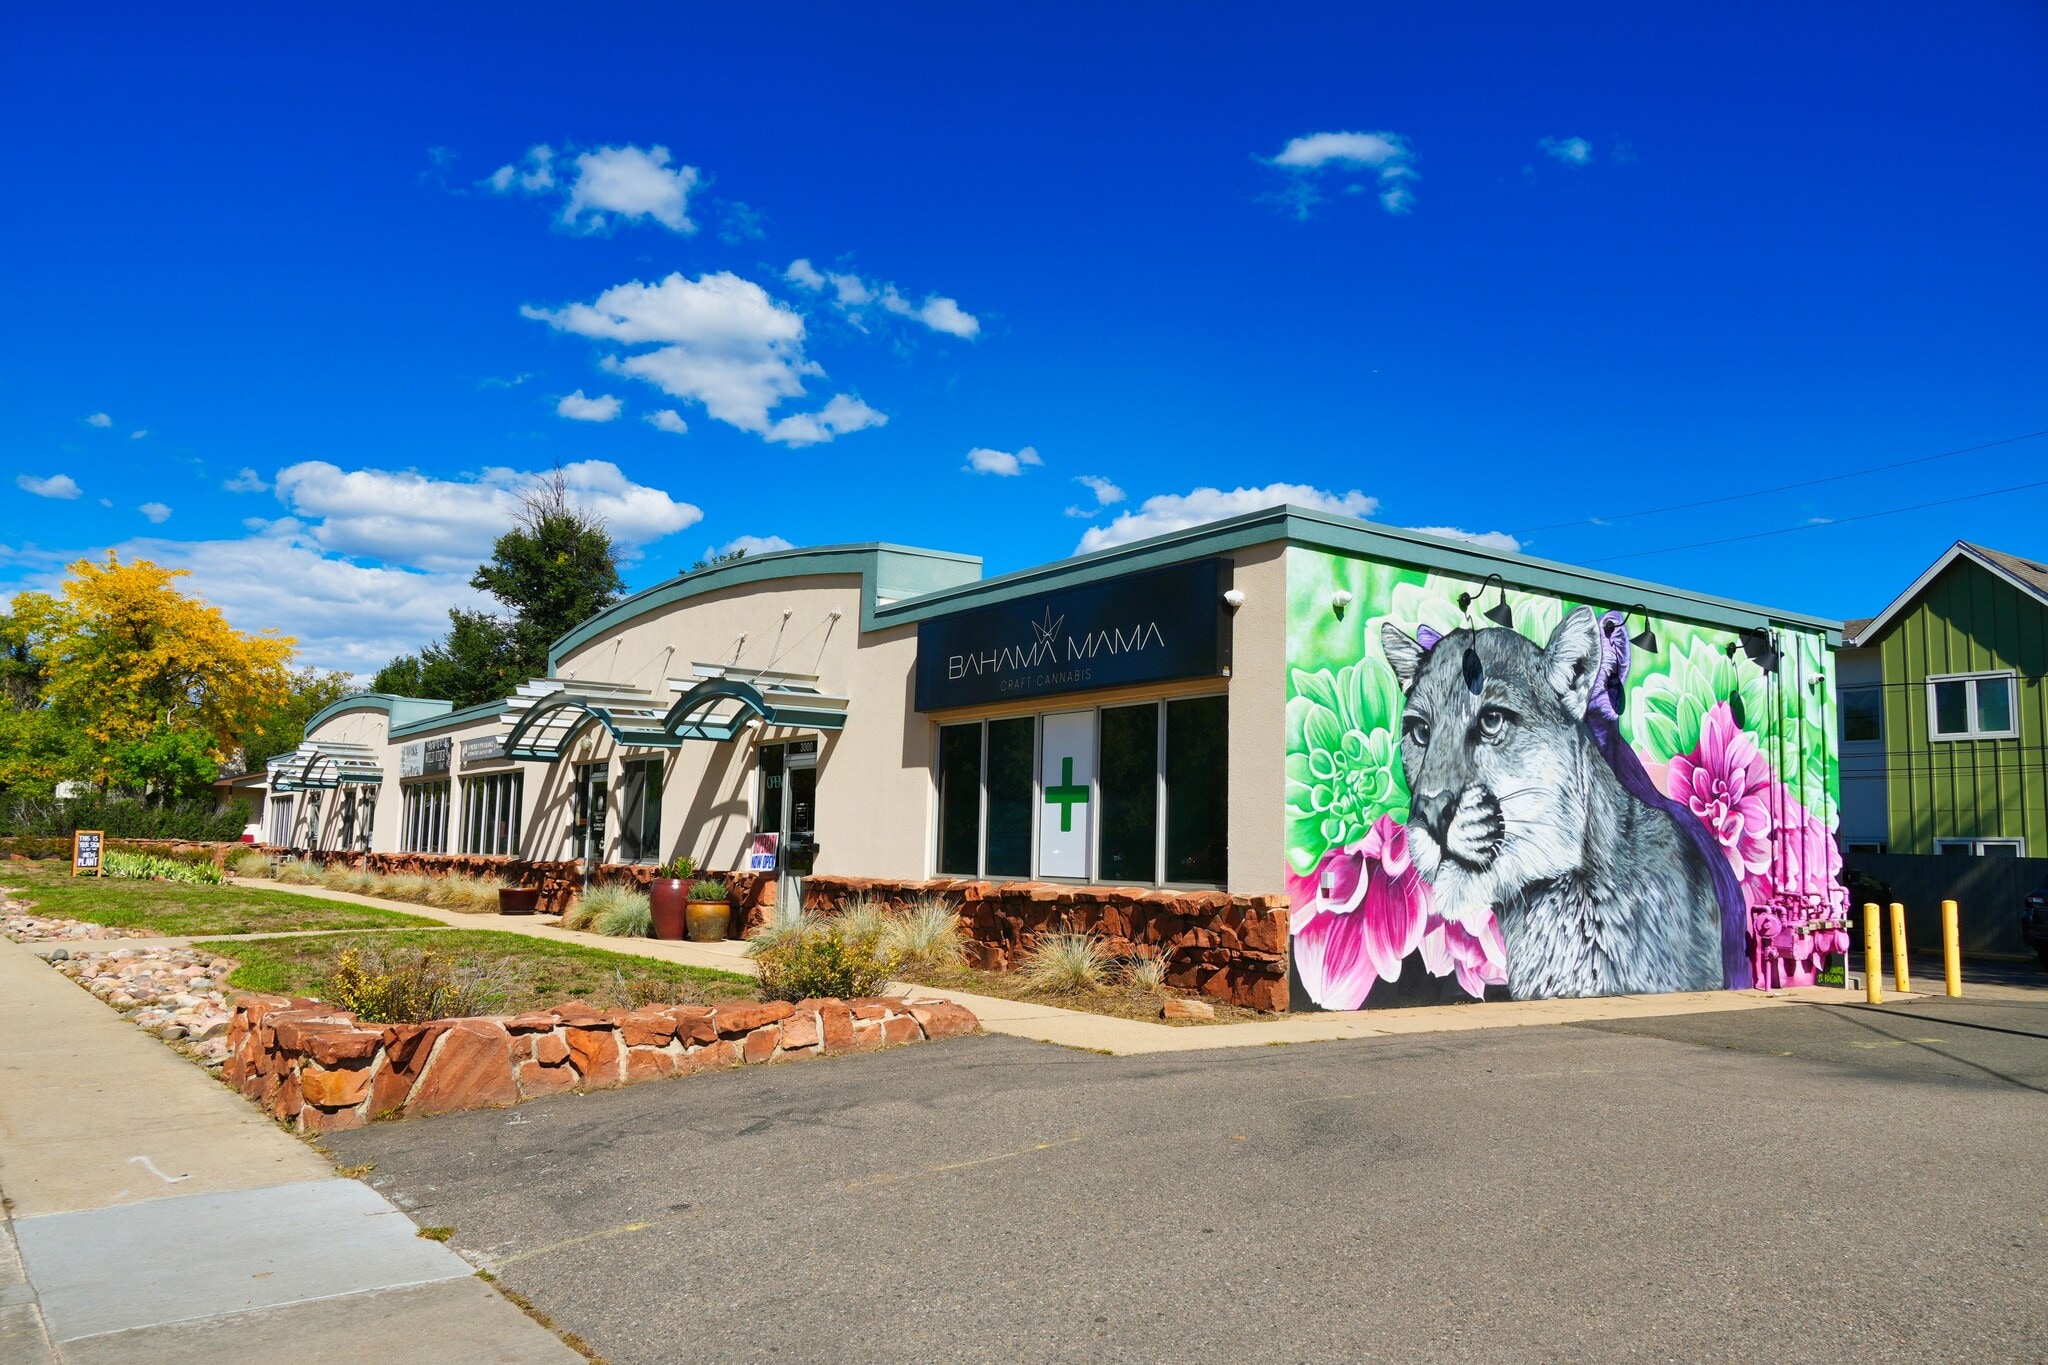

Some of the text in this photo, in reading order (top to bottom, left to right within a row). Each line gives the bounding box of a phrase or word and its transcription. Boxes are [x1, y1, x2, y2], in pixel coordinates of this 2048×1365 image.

[949, 621, 1165, 680] BAHAMA MAMA
[1000, 667, 1092, 692] CRAFT CANNABIS
[800, 742, 813, 753] 3000
[77, 857, 98, 867] PLANT
[751, 854, 776, 869] NOW OPEN
